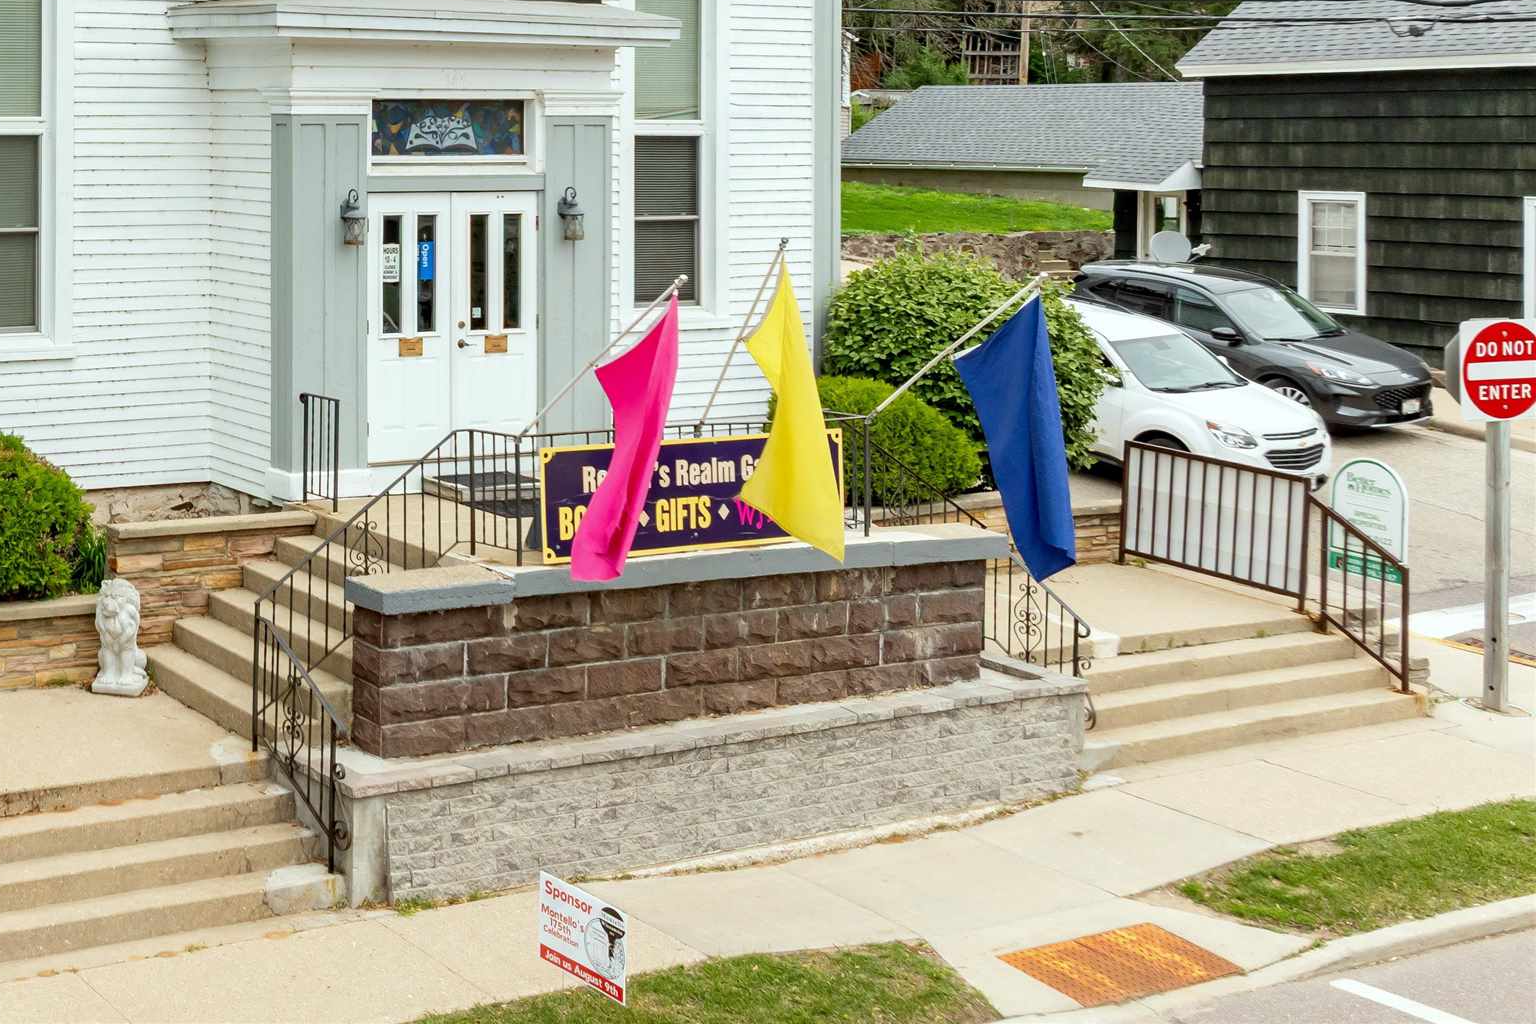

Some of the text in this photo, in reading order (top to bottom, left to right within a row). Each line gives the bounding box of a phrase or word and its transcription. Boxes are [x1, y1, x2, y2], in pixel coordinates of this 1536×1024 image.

[421, 244, 430, 267] Open
[1476, 340, 1535, 358] DO NOT
[1479, 383, 1532, 401] ENTER
[675, 457, 736, 487] Realm
[655, 495, 713, 533] GIFTS
[545, 880, 593, 915] Sponsor
[541, 903, 585, 933] Montello's
[550, 918, 571, 936] 175th
[544, 924, 579, 948] Celebration
[545, 949, 619, 997] Join us August 9th
